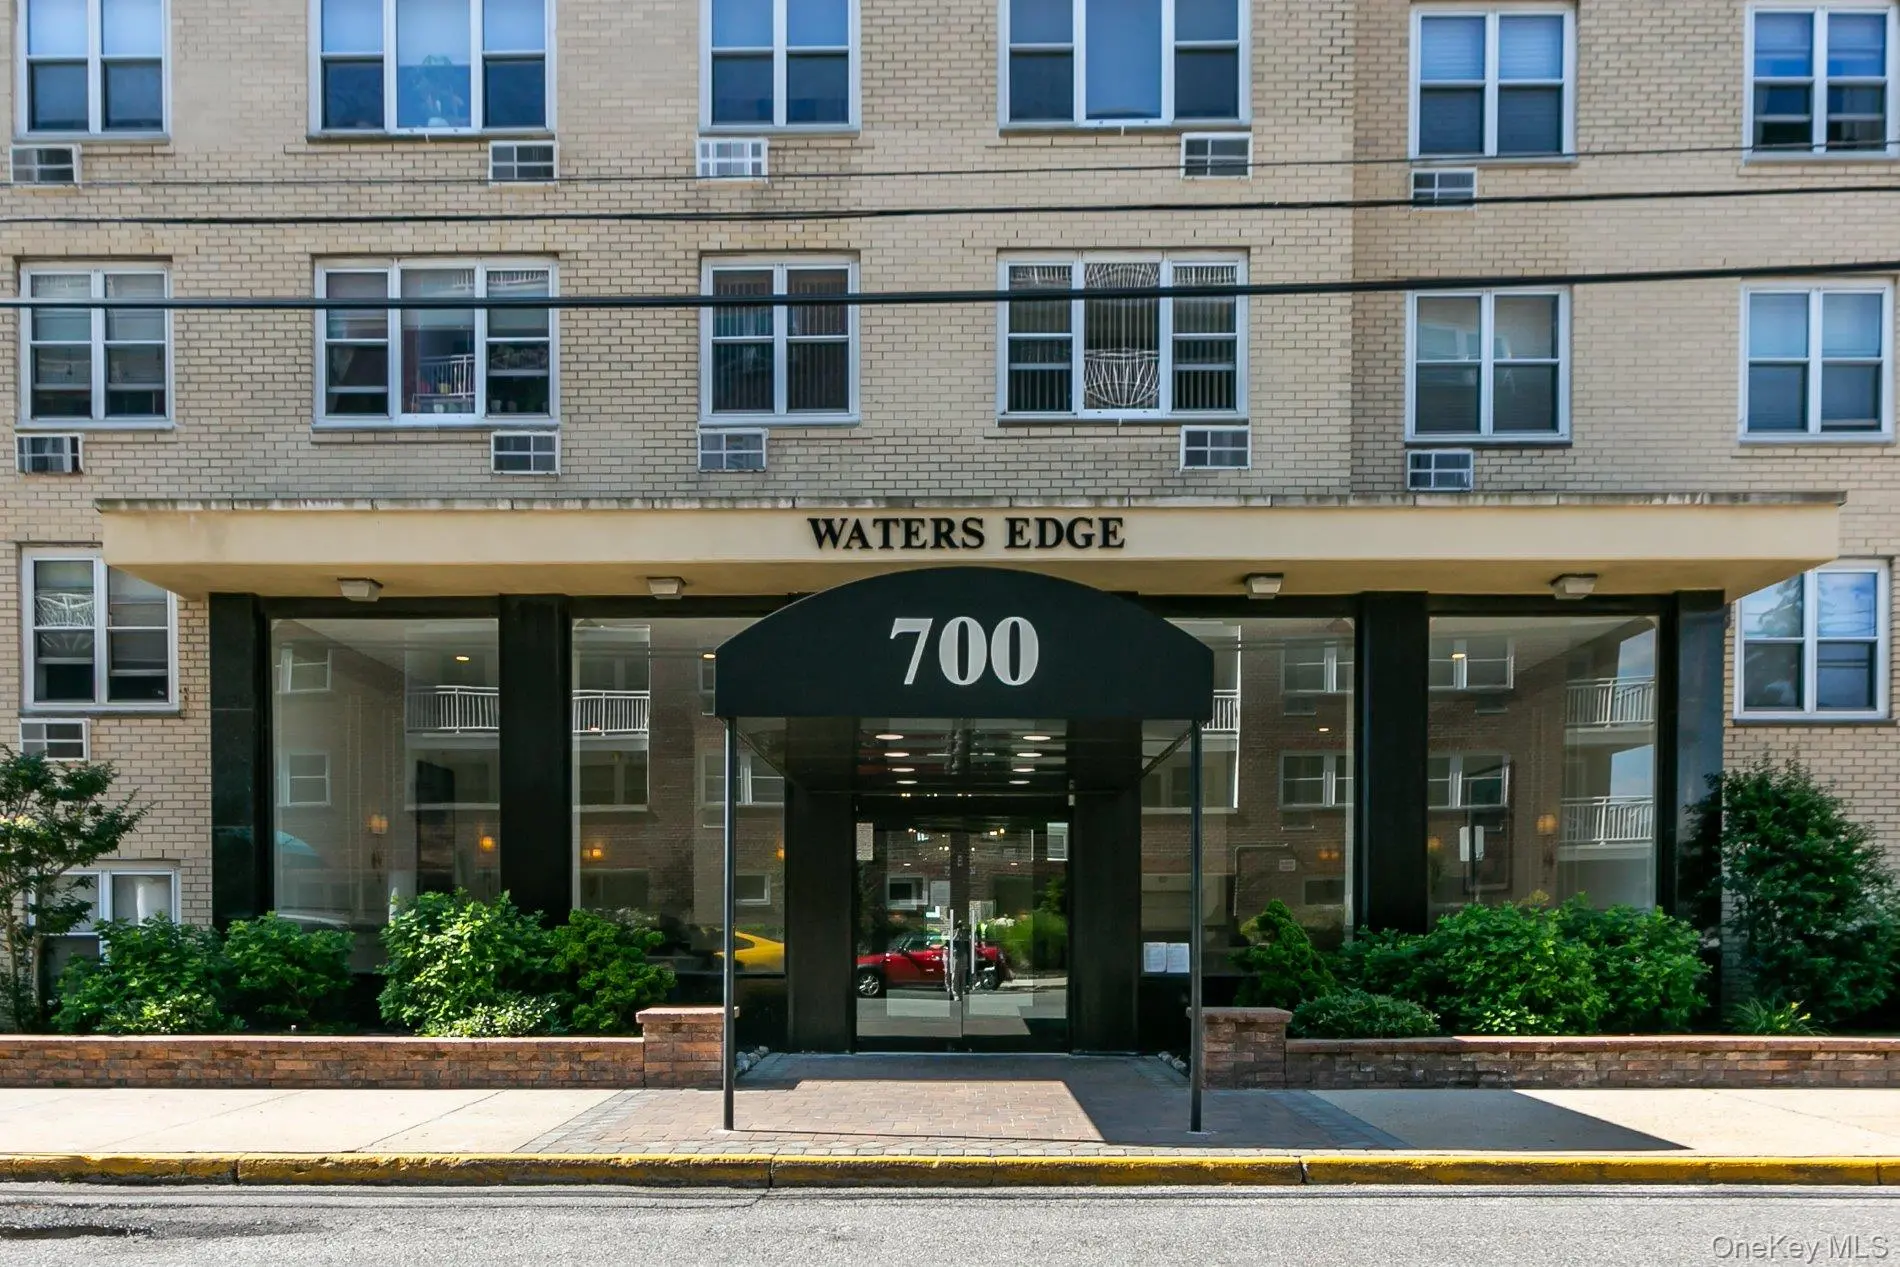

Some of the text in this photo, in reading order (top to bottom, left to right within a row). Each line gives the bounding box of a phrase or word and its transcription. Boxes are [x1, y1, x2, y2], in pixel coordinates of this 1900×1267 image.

[807, 517, 1126, 549] WATERS EDGE
[889, 616, 1040, 686] 700
